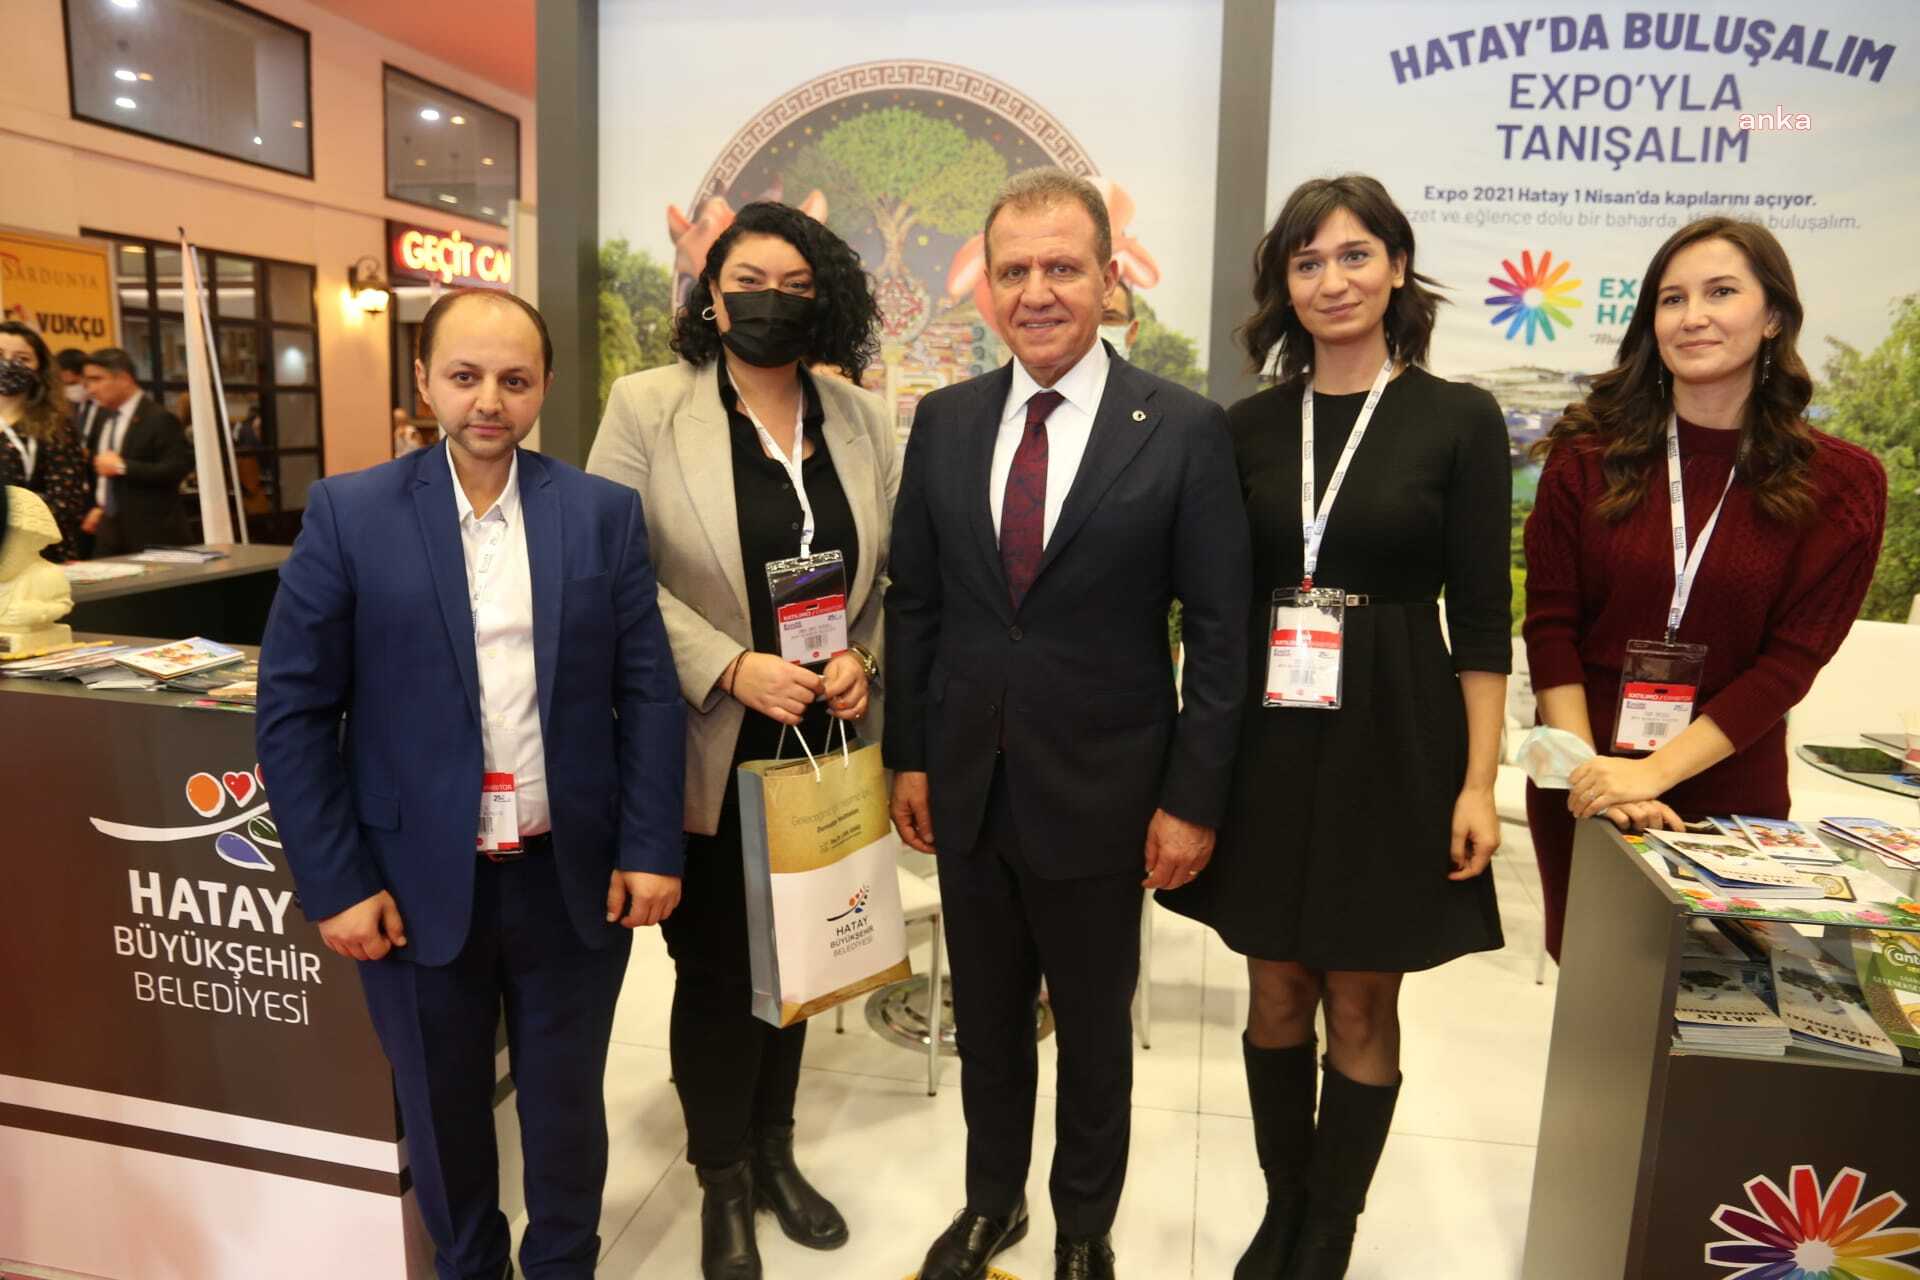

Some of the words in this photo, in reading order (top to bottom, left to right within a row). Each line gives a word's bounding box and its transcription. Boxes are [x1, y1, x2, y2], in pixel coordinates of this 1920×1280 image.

[1389, 13, 1610, 85] HATAY'DA
[1623, 12, 1897, 84] BULUŞALIM
[1509, 73, 1743, 111] EXPO'YLA
[1496, 124, 1749, 171] TANIŞALIM
[1424, 186, 1468, 204] Expo
[1473, 187, 1513, 201] 2021
[1518, 189, 1569, 206] Hatay
[1585, 190, 1661, 205] Nisan'da
[1665, 190, 1750, 208] kapılarını
[1754, 194, 1818, 209] açıyor.
[402, 229, 474, 284] GEÇİT
[1600, 277, 1638, 299] EX
[128, 869, 293, 935] HATAY
[836, 916, 868, 937] HATAY
[113, 922, 322, 984] BÜYÜKŞEHİR
[134, 971, 310, 1026] BELEDİYESİ
